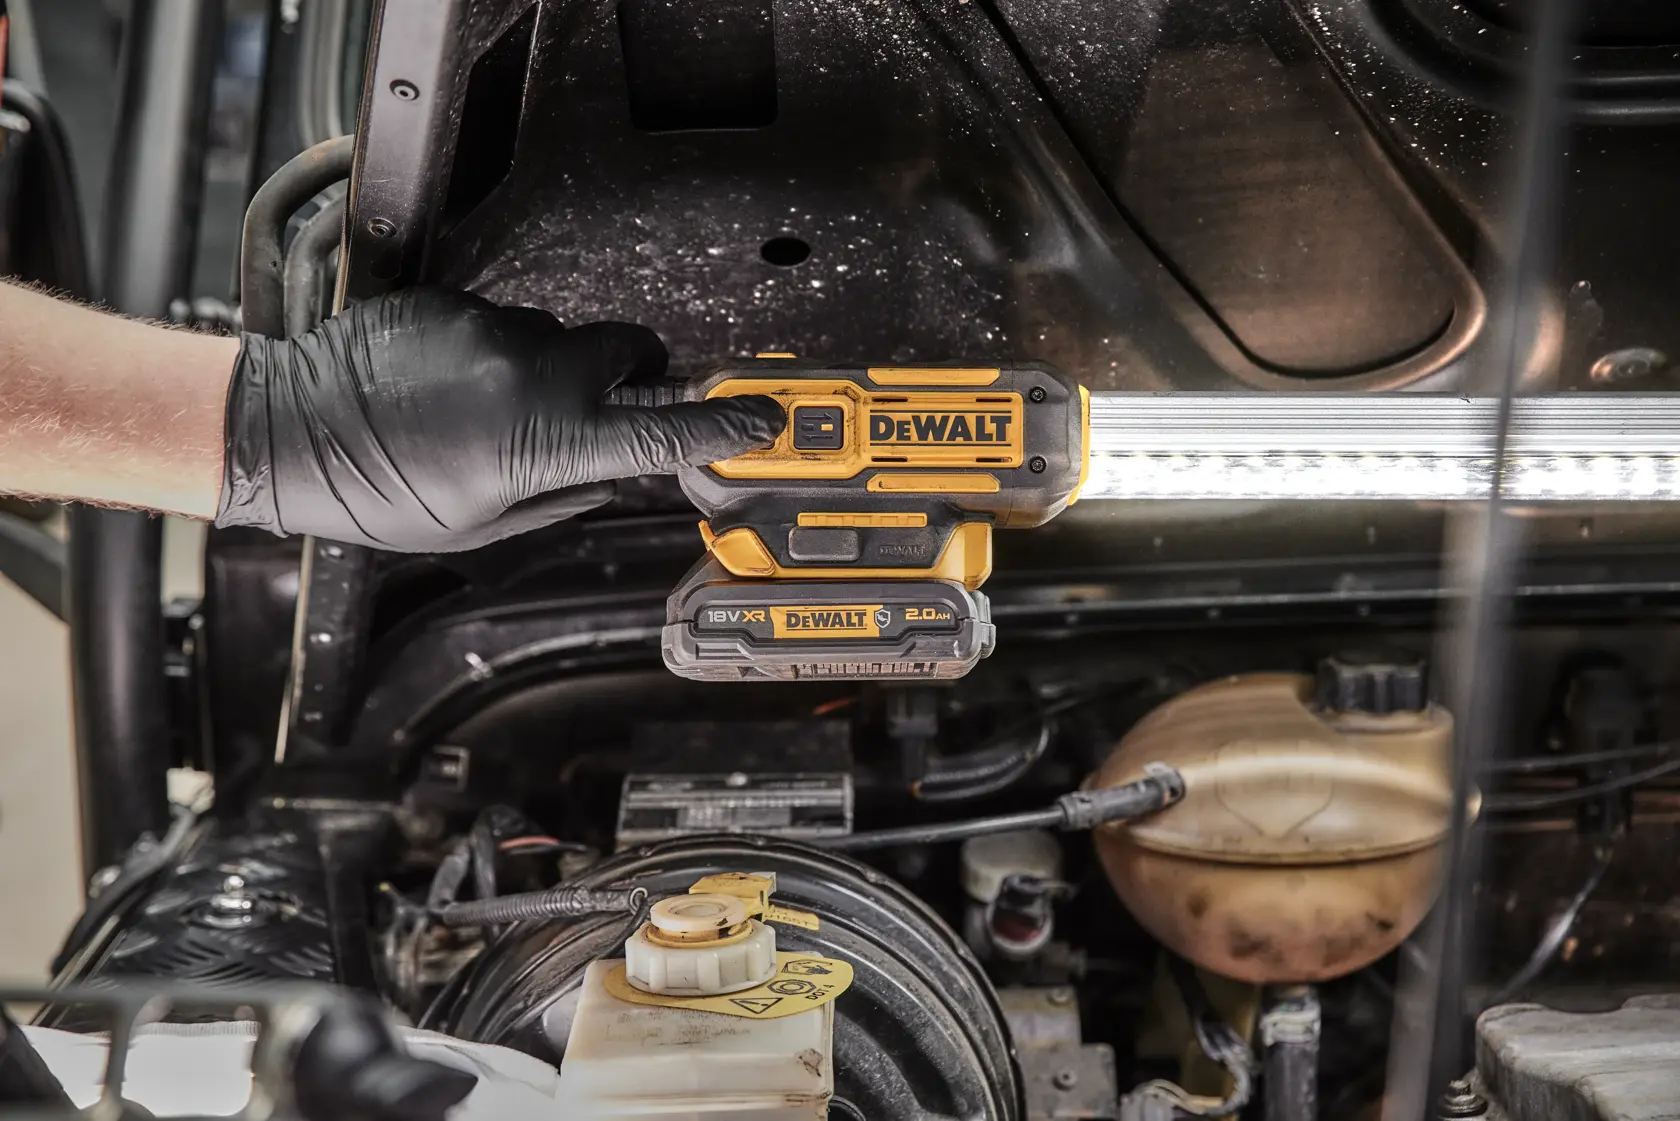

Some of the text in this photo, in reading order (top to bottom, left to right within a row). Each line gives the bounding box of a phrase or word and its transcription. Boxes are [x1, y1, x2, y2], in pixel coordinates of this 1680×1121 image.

[870, 415, 1012, 441] DEWALT
[786, 612, 866, 628] DEWALT
[805, 988, 829, 1000] DOT
